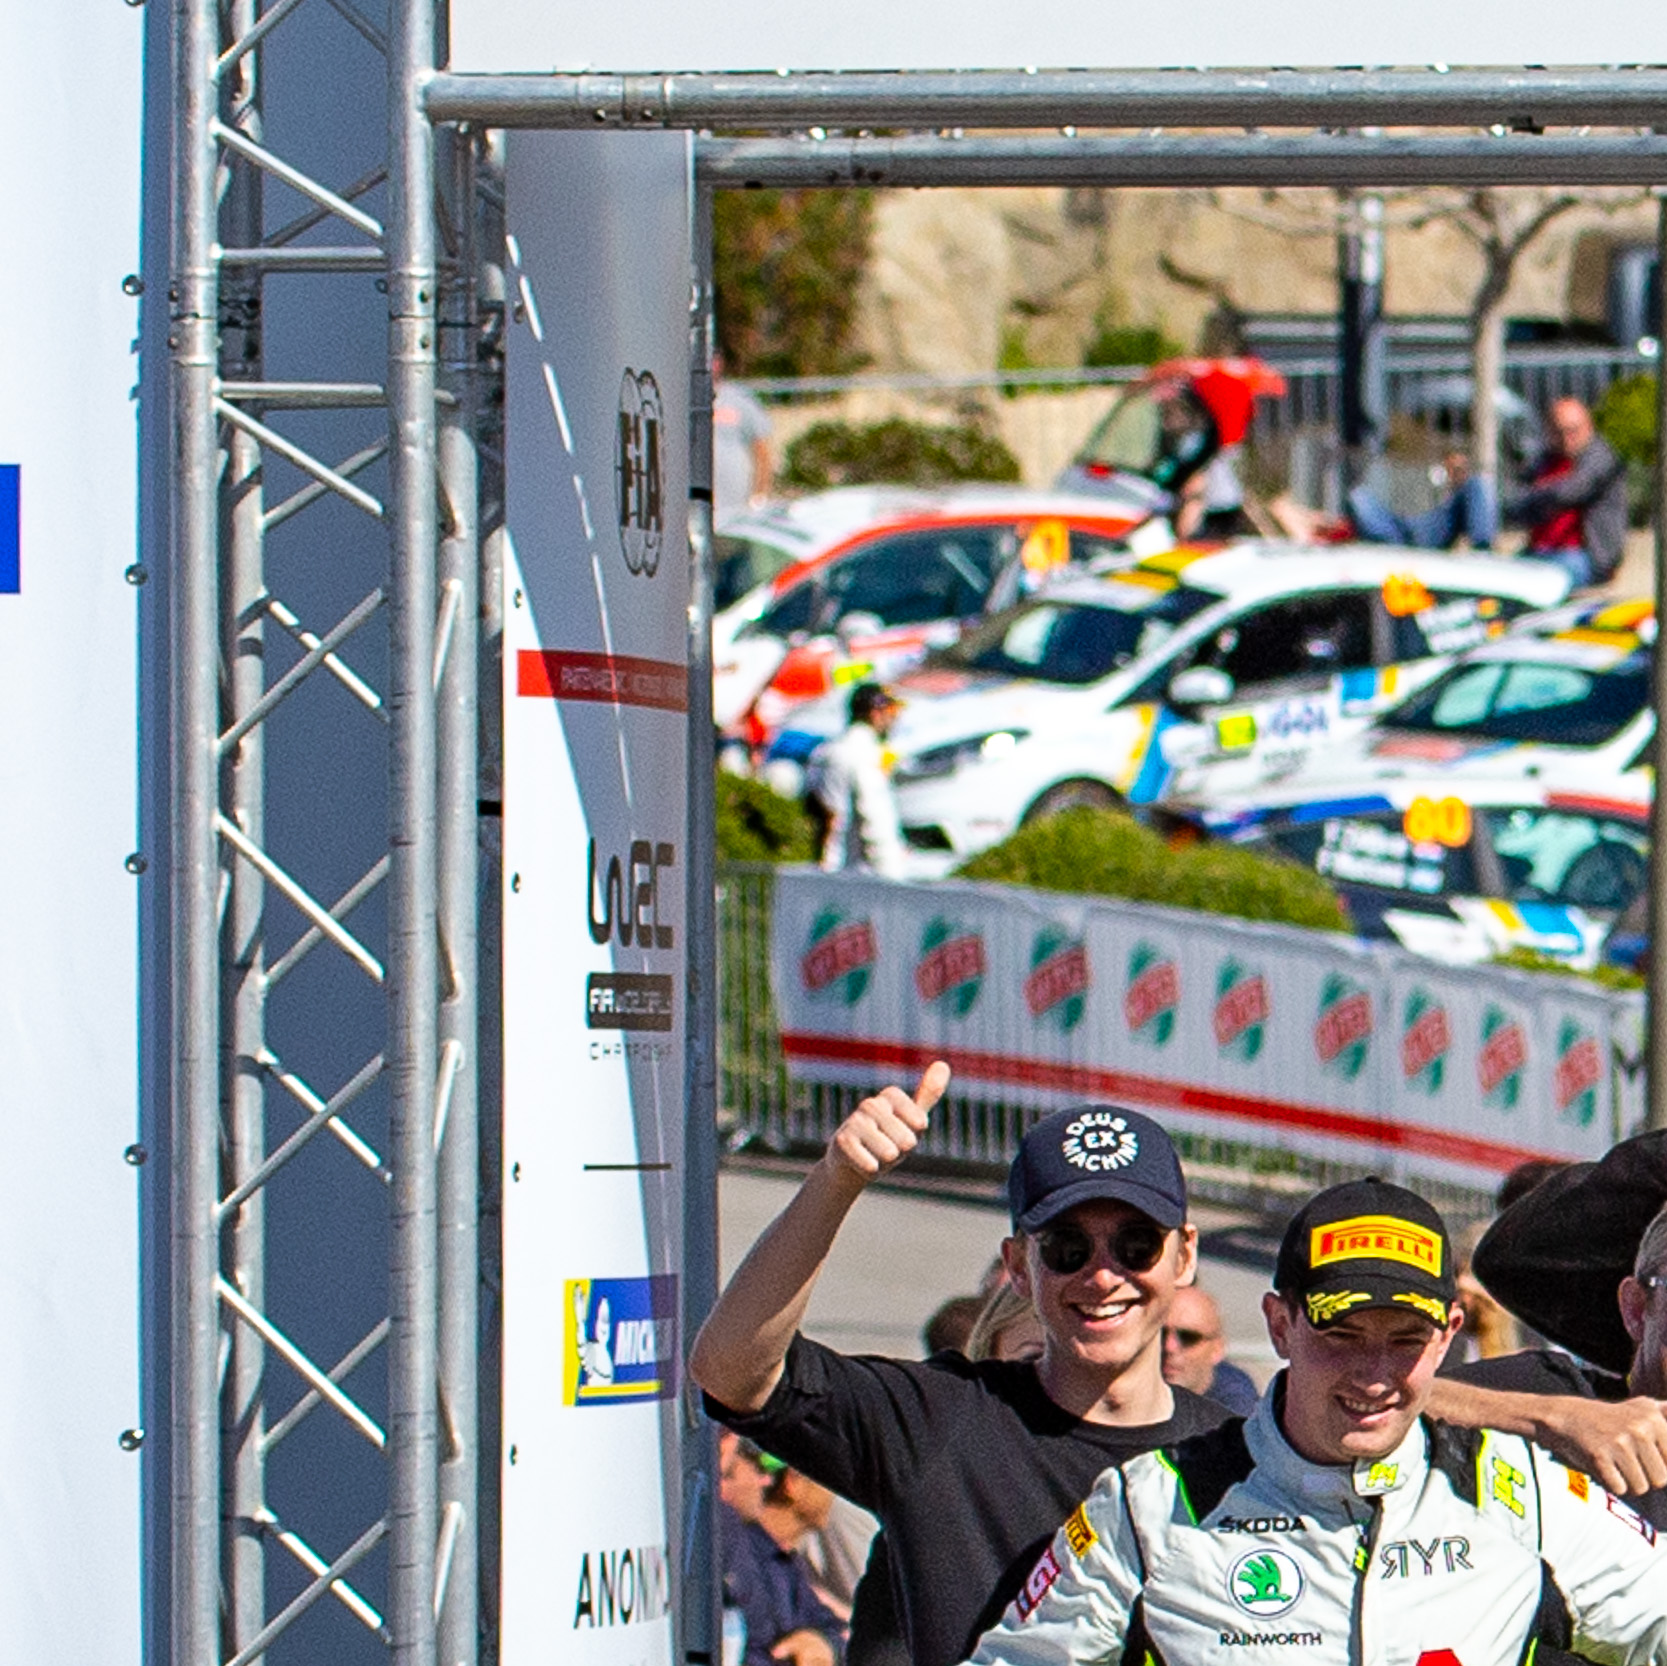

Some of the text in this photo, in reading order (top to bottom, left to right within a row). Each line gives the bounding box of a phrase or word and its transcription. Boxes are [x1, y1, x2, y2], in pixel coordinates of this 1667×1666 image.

[1065, 1111, 1128, 1137] DEUS
[1062, 1131, 1140, 1172] MACHINA
[1084, 1130, 1116, 1149] EX
[1318, 1218, 1435, 1264] PIRELLI
[1219, 1630, 1323, 1647] RAINWORTH
